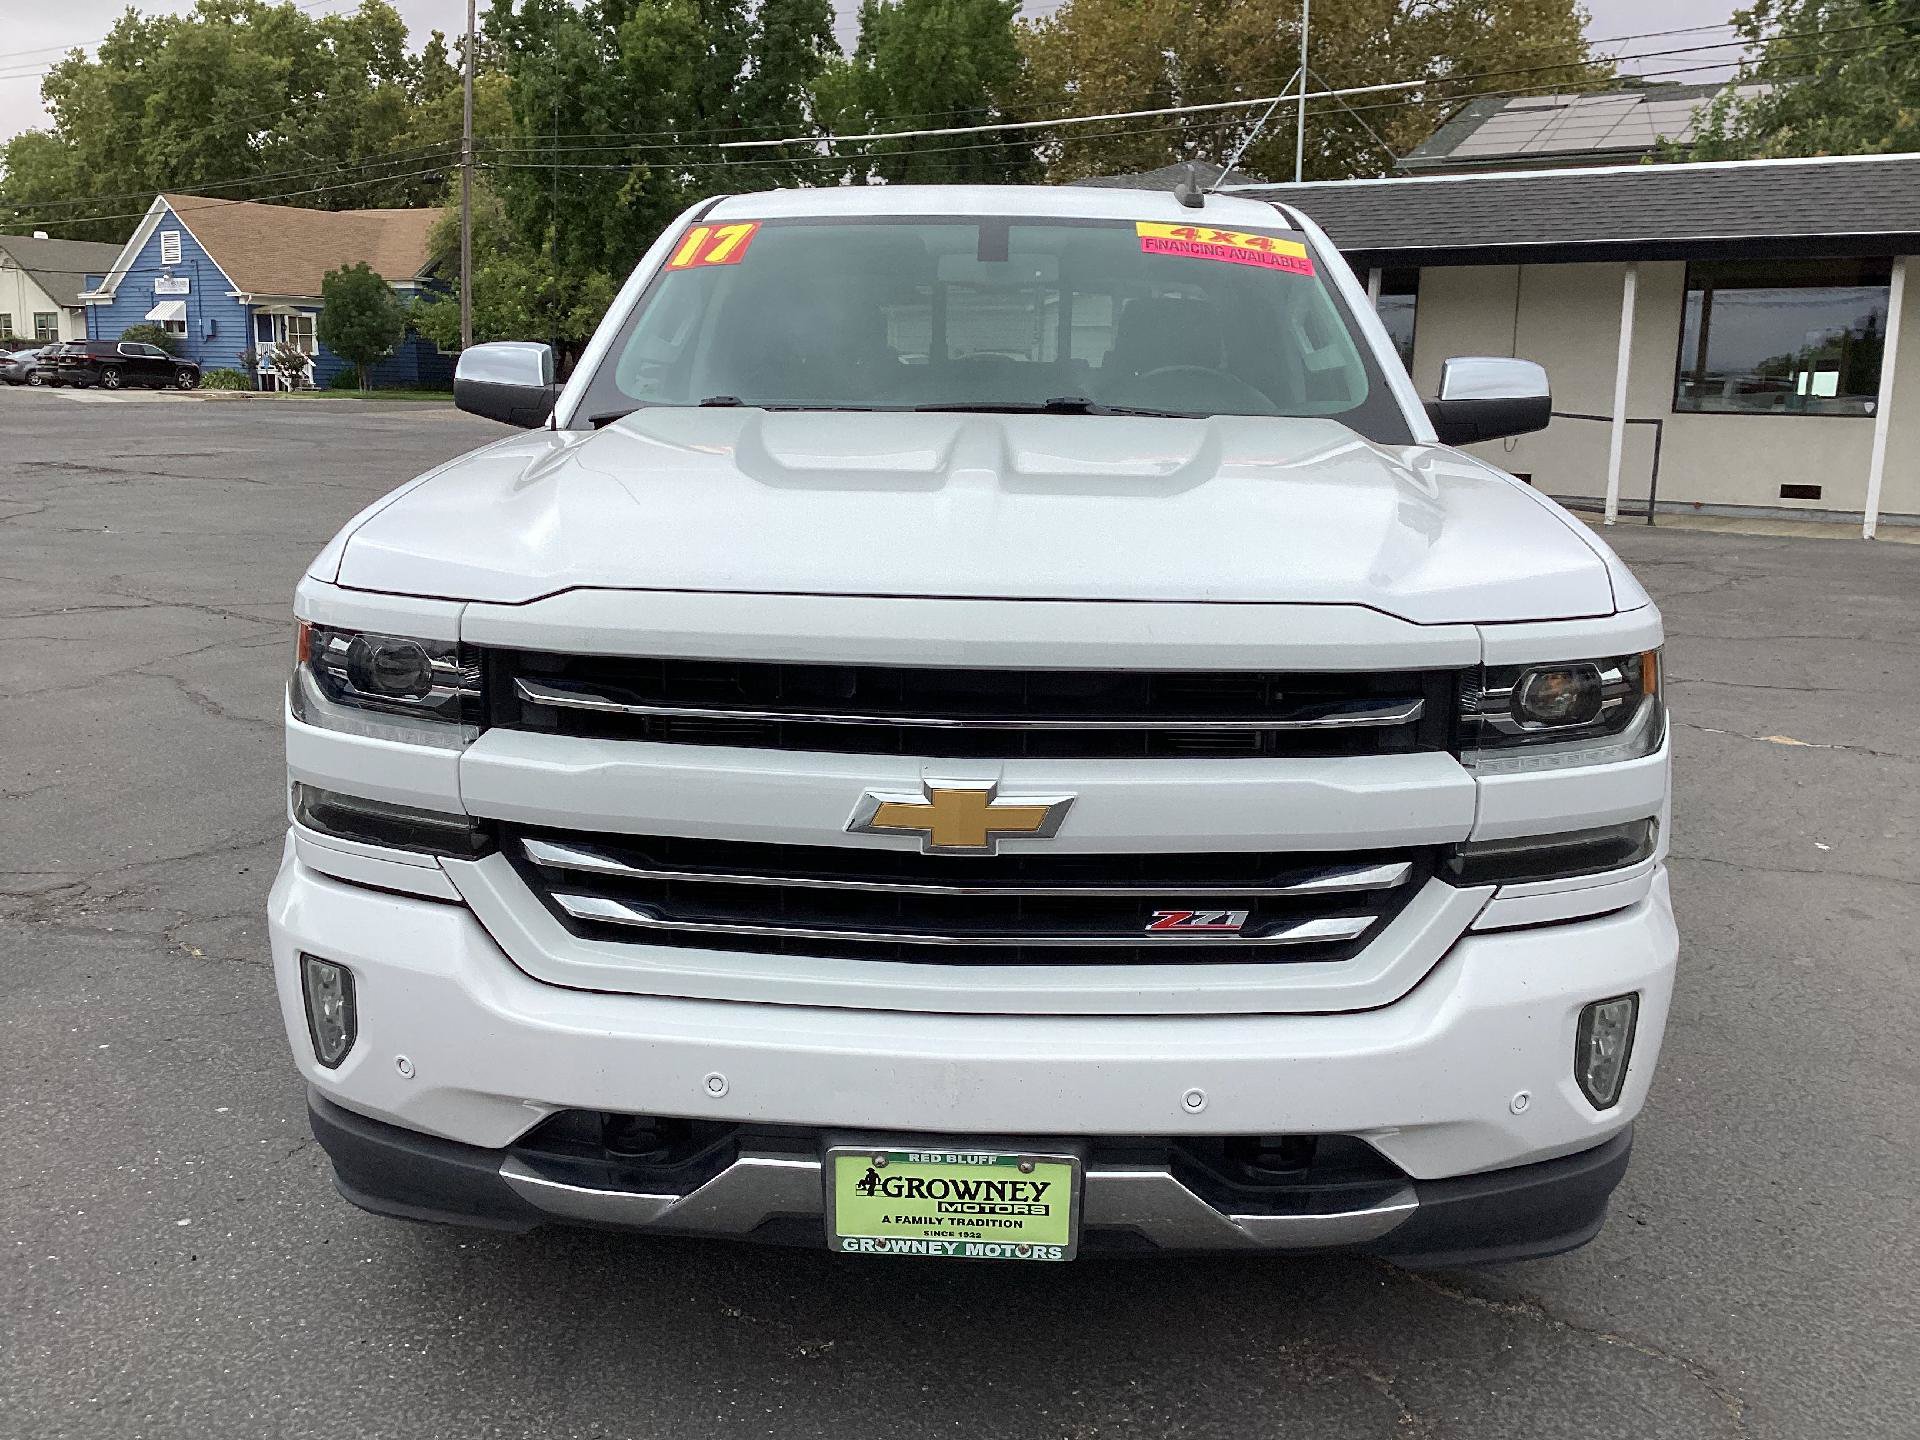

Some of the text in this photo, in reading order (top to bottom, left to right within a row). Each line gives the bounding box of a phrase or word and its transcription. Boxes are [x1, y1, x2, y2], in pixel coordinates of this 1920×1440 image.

[672, 223, 754, 266] 17
[1145, 238, 1308, 271] FINANCING AVAILABLE
[1145, 911, 1249, 930] Z71
[908, 1153, 998, 1165] RED BLUFF
[882, 1176, 1051, 1202] GROWNEY
[941, 1203, 1046, 1215] MOTORS
[881, 1215, 1023, 1228] A FAMILY TRADITION
[842, 1238, 1062, 1259] GROWNEY MOTORS
